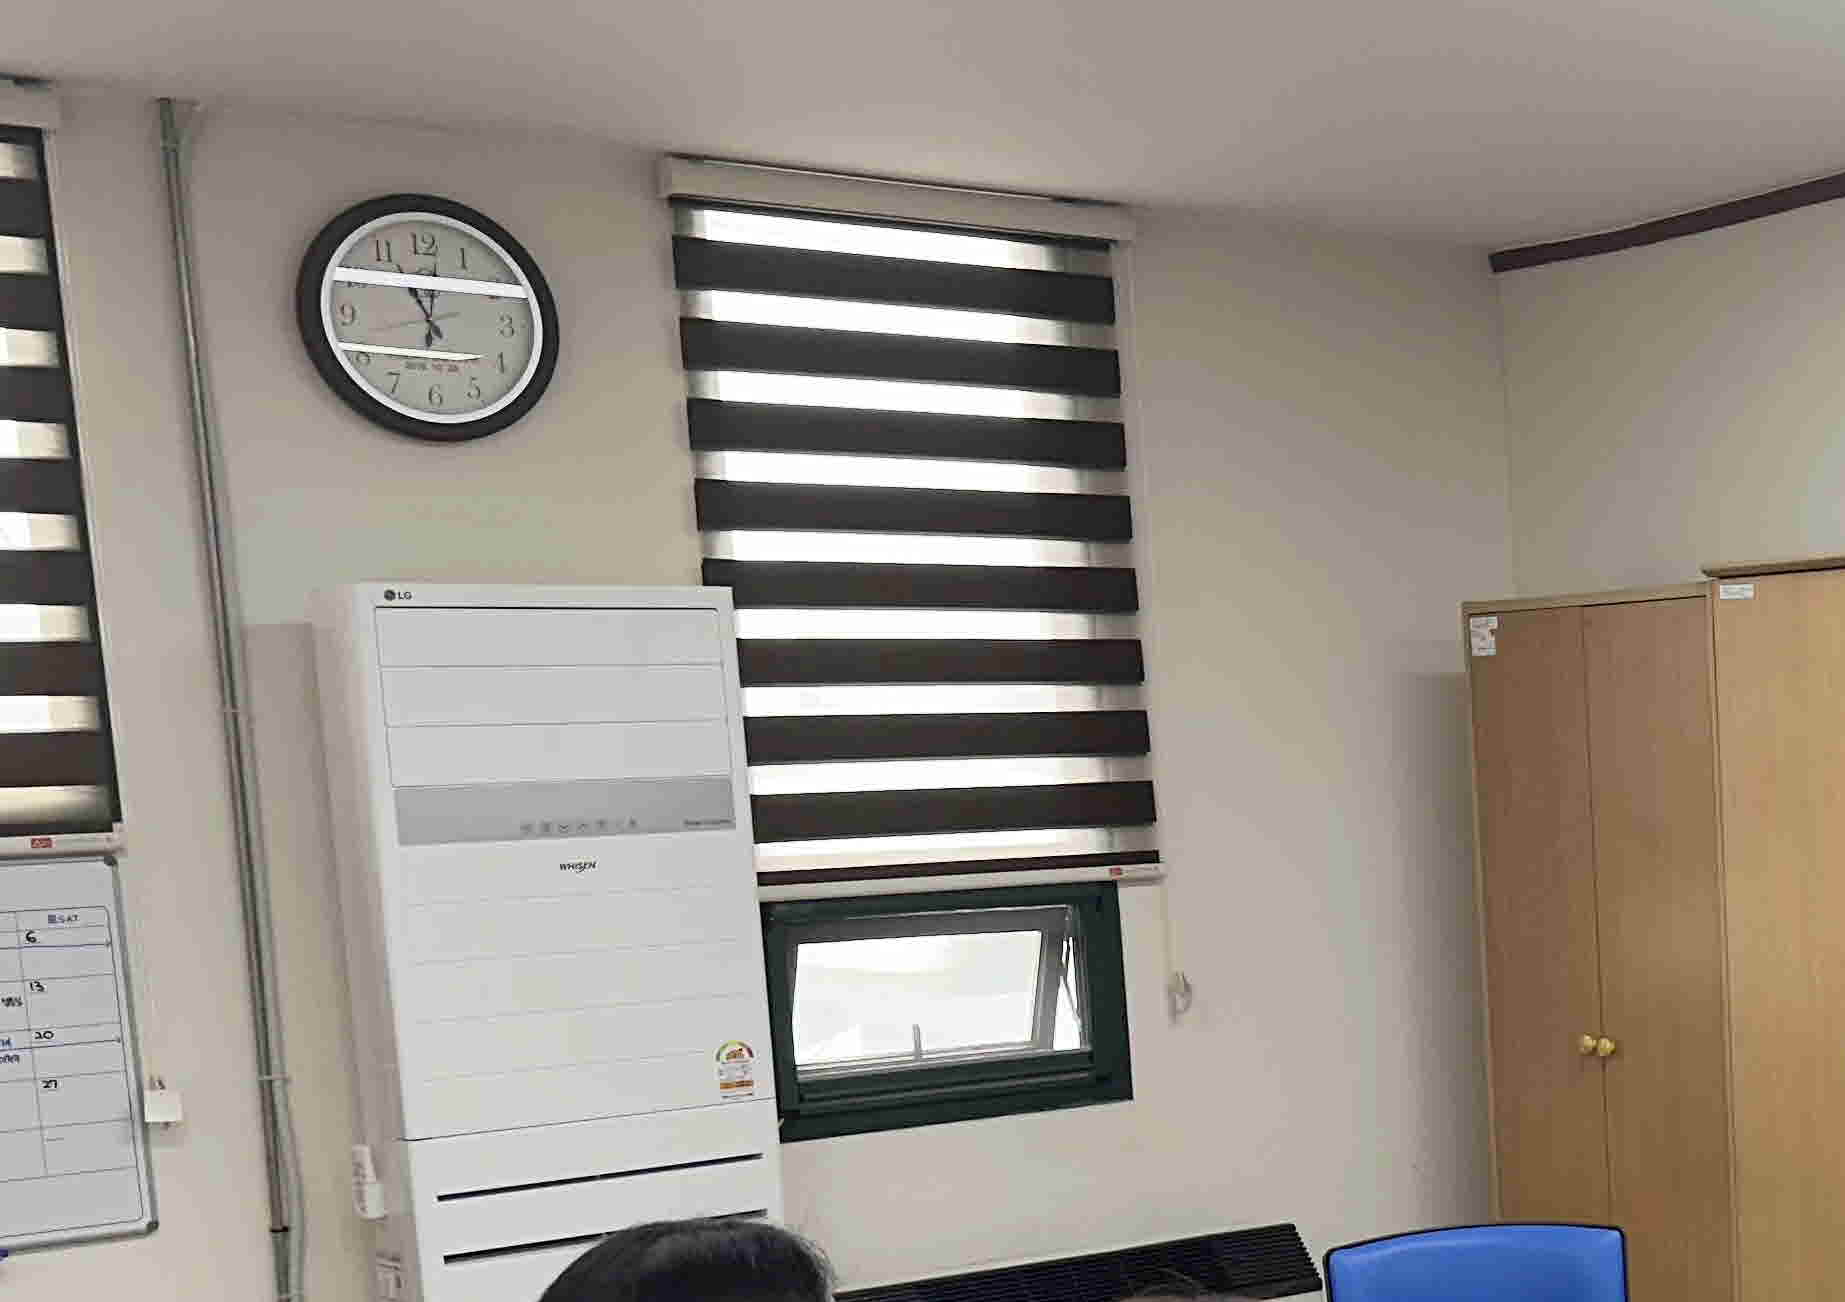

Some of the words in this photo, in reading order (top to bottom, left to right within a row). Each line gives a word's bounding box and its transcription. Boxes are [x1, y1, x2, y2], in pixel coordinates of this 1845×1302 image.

[374, 240, 393, 263] 11
[409, 232, 438, 256] 12
[458, 247, 468, 271] 1
[340, 305, 358, 327] 9
[496, 316, 516, 338] 3
[387, 372, 402, 394] 7
[467, 377, 482, 400] 5
[428, 384, 444, 406] 6
[398, 591, 412, 600] LG
[25, 930, 37, 943] 6
[29, 980, 46, 992] 13
[34, 1030, 55, 1040] 20
